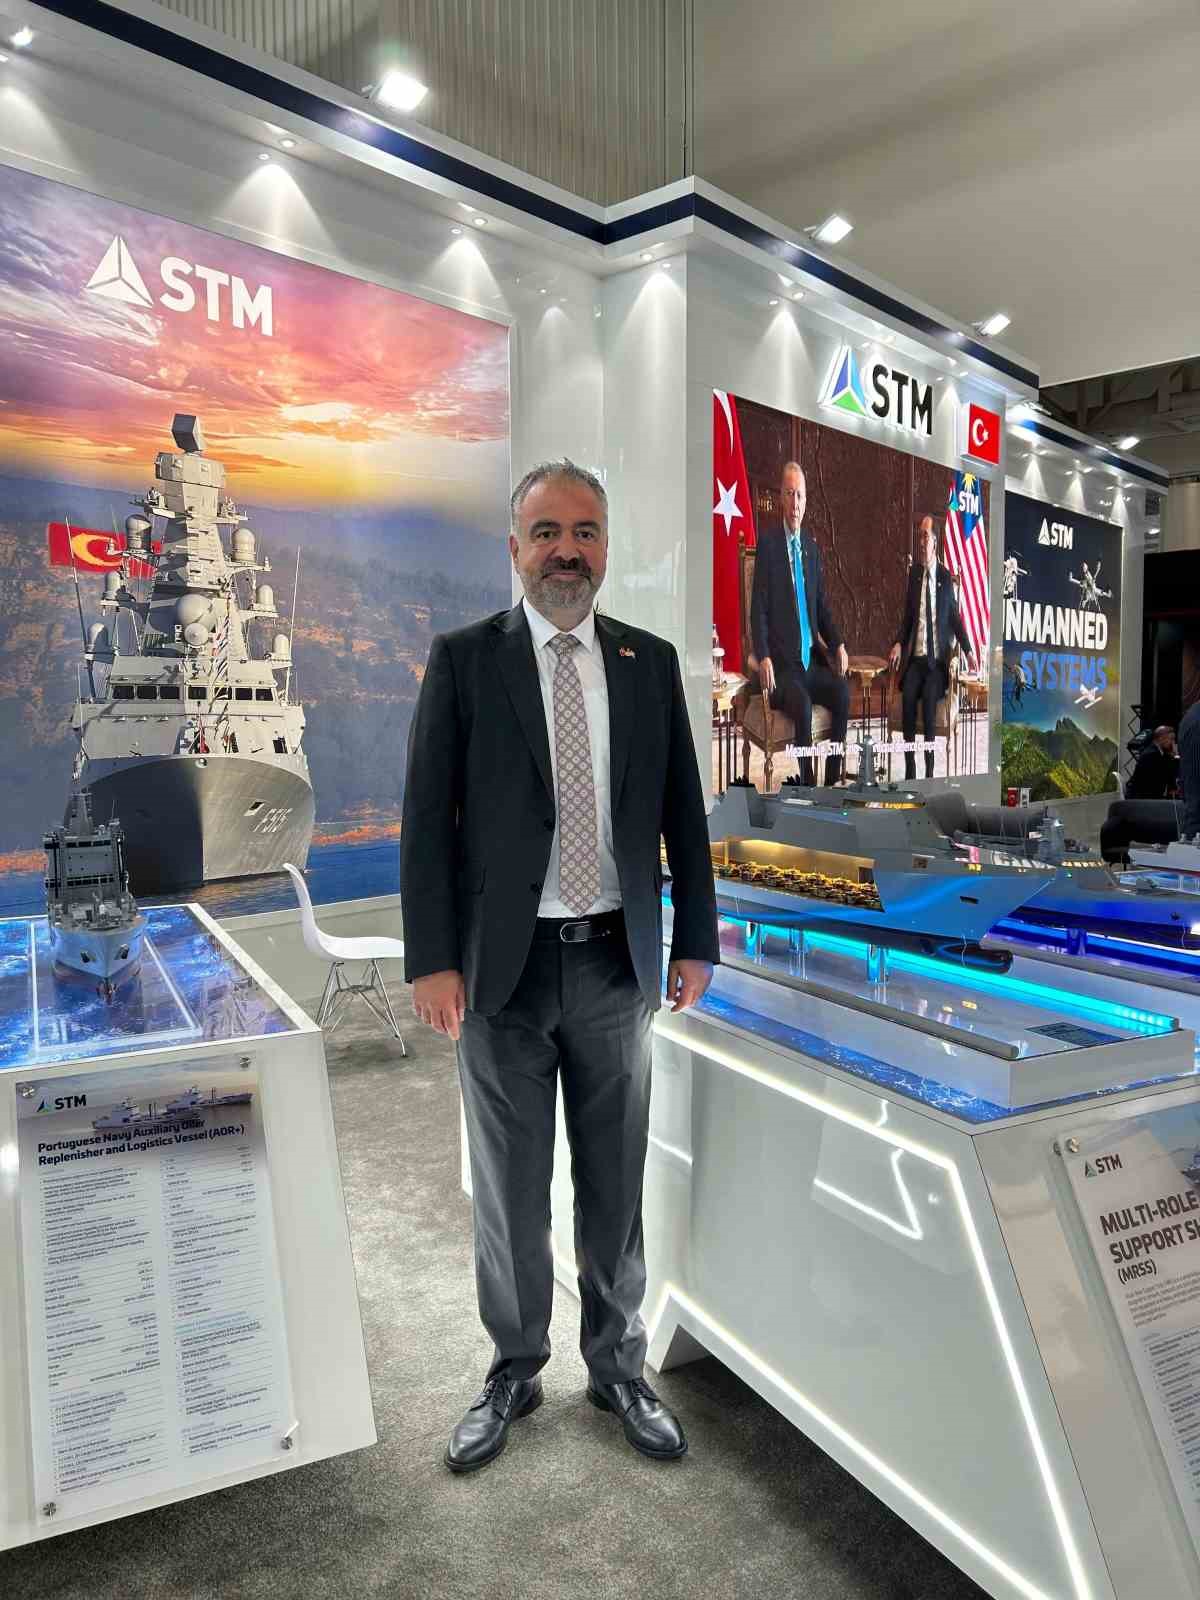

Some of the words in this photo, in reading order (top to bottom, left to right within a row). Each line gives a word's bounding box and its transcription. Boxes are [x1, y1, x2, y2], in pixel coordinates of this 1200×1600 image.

[160, 256, 272, 336] STM
[871, 364, 933, 436] STM
[959, 490, 979, 516] STM
[1051, 522, 1073, 550] STM
[1021, 650, 1109, 692] SYSTEMS
[785, 743, 826, 760] Meanwhile,
[54, 1094, 87, 1111] STM
[38, 1135, 103, 1153] Portuguese
[104, 1131, 130, 1145] Navy
[133, 1122, 180, 1139] Auxiliary
[38, 1148, 105, 1167] Replenisher
[106, 1144, 126, 1155] and
[127, 1137, 173, 1153] Logistics
[174, 1131, 208, 1144] Vessel
[1095, 1153, 1122, 1173] STM
[1099, 1190, 1200, 1236] MULTI-ROLE
[1110, 1223, 1185, 1264] SUPPORT
[1117, 1259, 1158, 1286] (MRSS)
